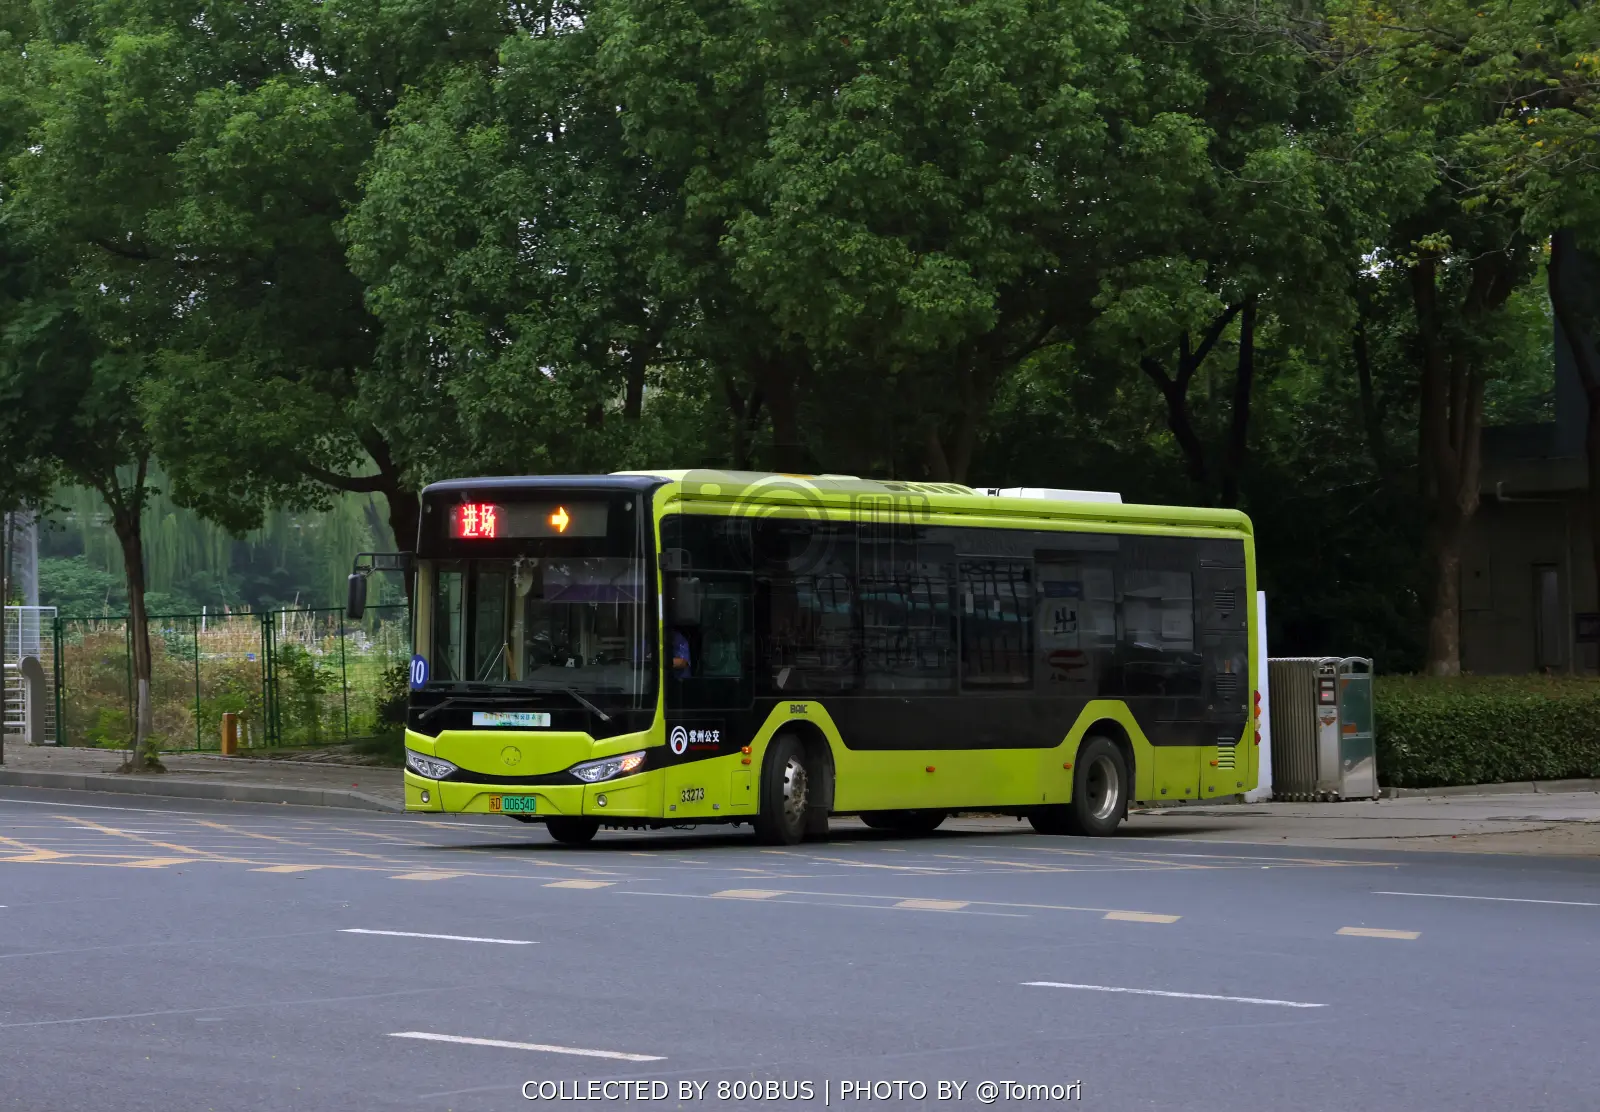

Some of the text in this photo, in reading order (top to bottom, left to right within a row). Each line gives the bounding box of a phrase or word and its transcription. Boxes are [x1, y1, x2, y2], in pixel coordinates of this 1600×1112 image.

[462, 504, 496, 538] 进场
[410, 659, 425, 684] 10
[789, 704, 808, 714] BAIC
[689, 729, 720, 743] 常州公交
[681, 787, 705, 803] 33273
